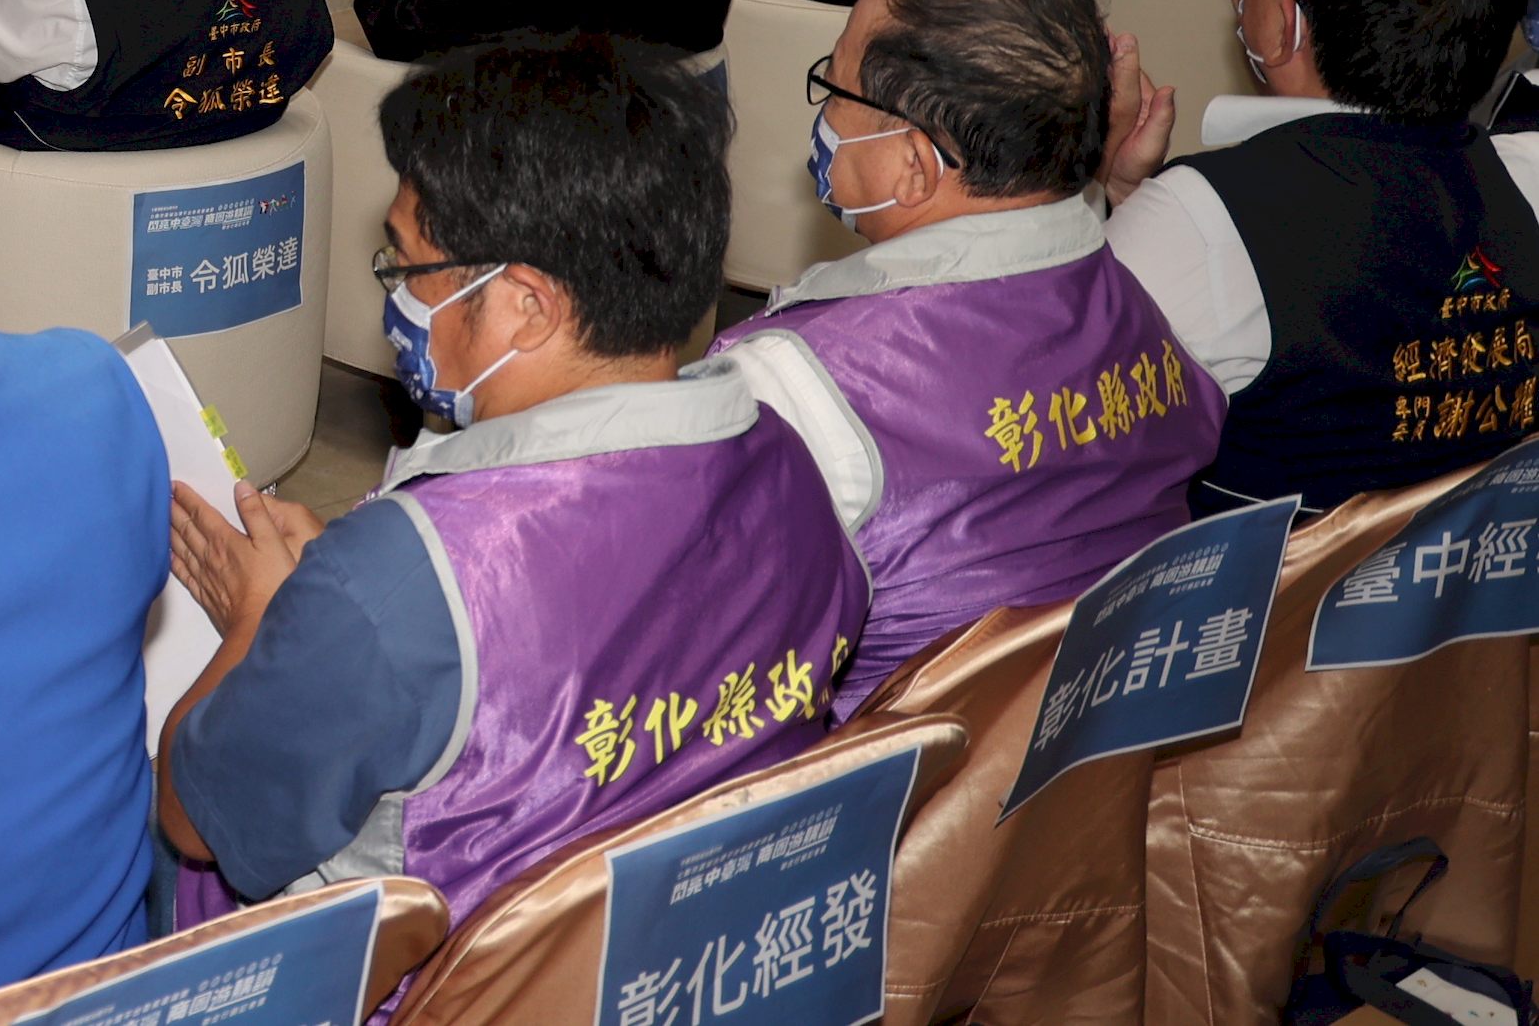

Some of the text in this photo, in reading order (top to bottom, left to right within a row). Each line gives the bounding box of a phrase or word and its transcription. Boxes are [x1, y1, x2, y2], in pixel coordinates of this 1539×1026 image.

[208, 16, 262, 42] 臺中市政府
[182, 40, 278, 79] 副市長
[163, 72, 285, 120] 令狐榮達
[146, 280, 183, 296] 副市長
[147, 265, 184, 282] 臺中市
[190, 236, 299, 294] 令狐榮達
[1392, 318, 1536, 382] 經濟發展局
[984, 339, 1188, 473] 彰化縣政府
[1335, 517, 1539, 608] 臺中經
[1034, 607, 1253, 752] 彰化計畫
[617, 868, 878, 1026] 彰化經發
